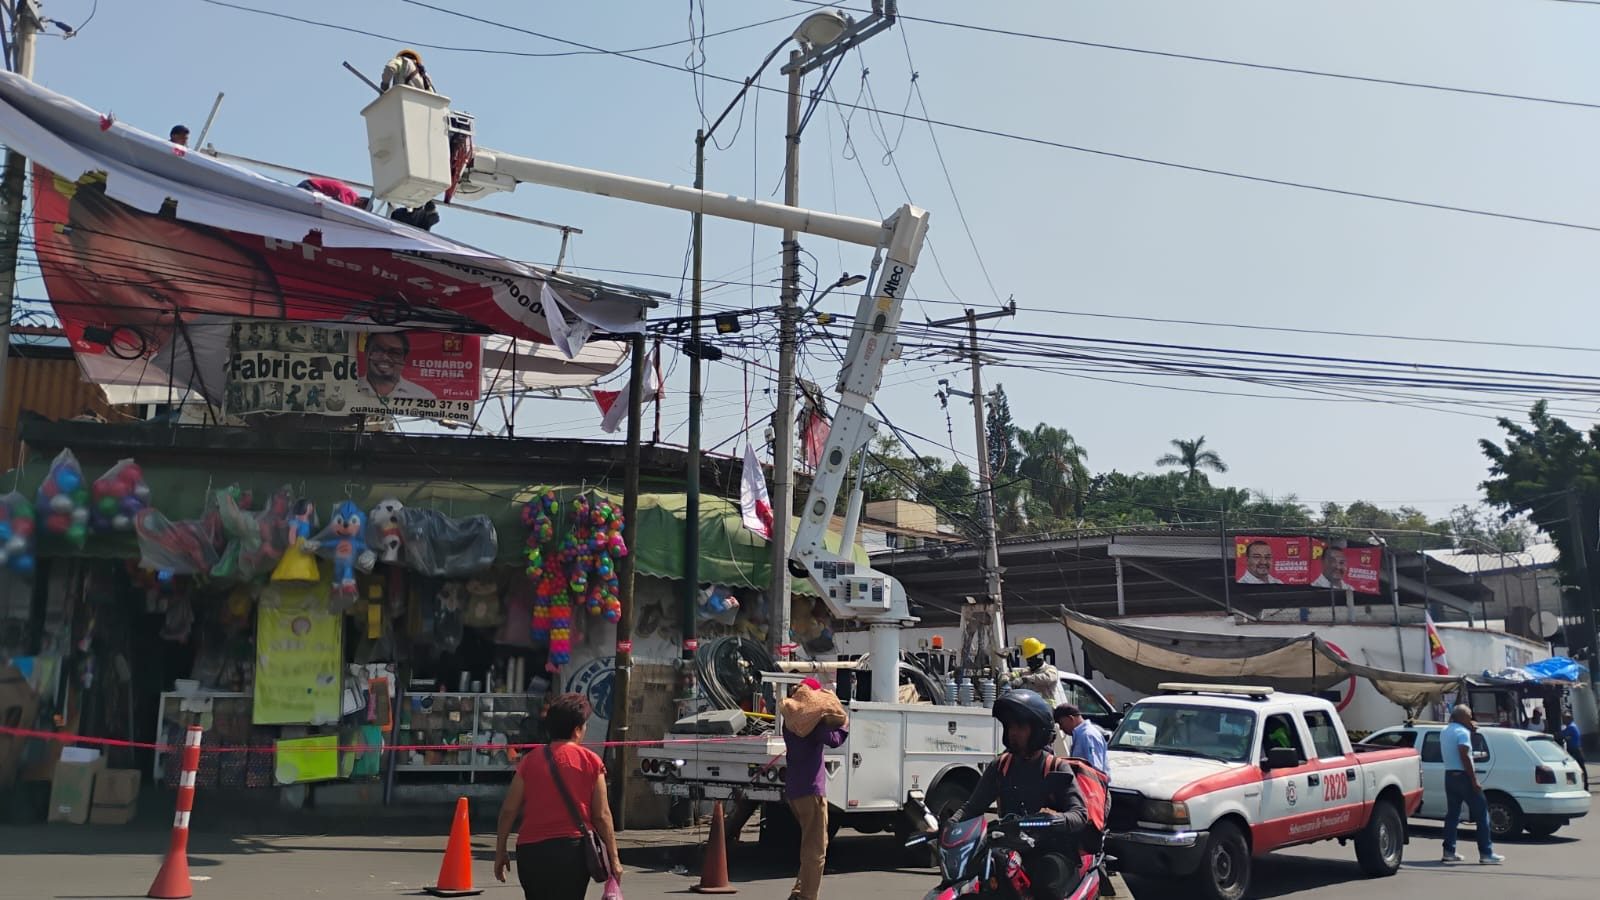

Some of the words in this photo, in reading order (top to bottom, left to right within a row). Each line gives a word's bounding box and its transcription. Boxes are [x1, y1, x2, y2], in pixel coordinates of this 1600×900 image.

[883, 265, 904, 298] Altec
[444, 340, 461, 351] PT
[231, 352, 324, 381] Fabrica
[412, 359, 473, 370] LEONARDO
[393, 397, 414, 407] 777
[416, 399, 436, 409] 250
[439, 400, 452, 410] 37
[457, 402, 470, 411] 19
[1324, 772, 1347, 801] 2828
